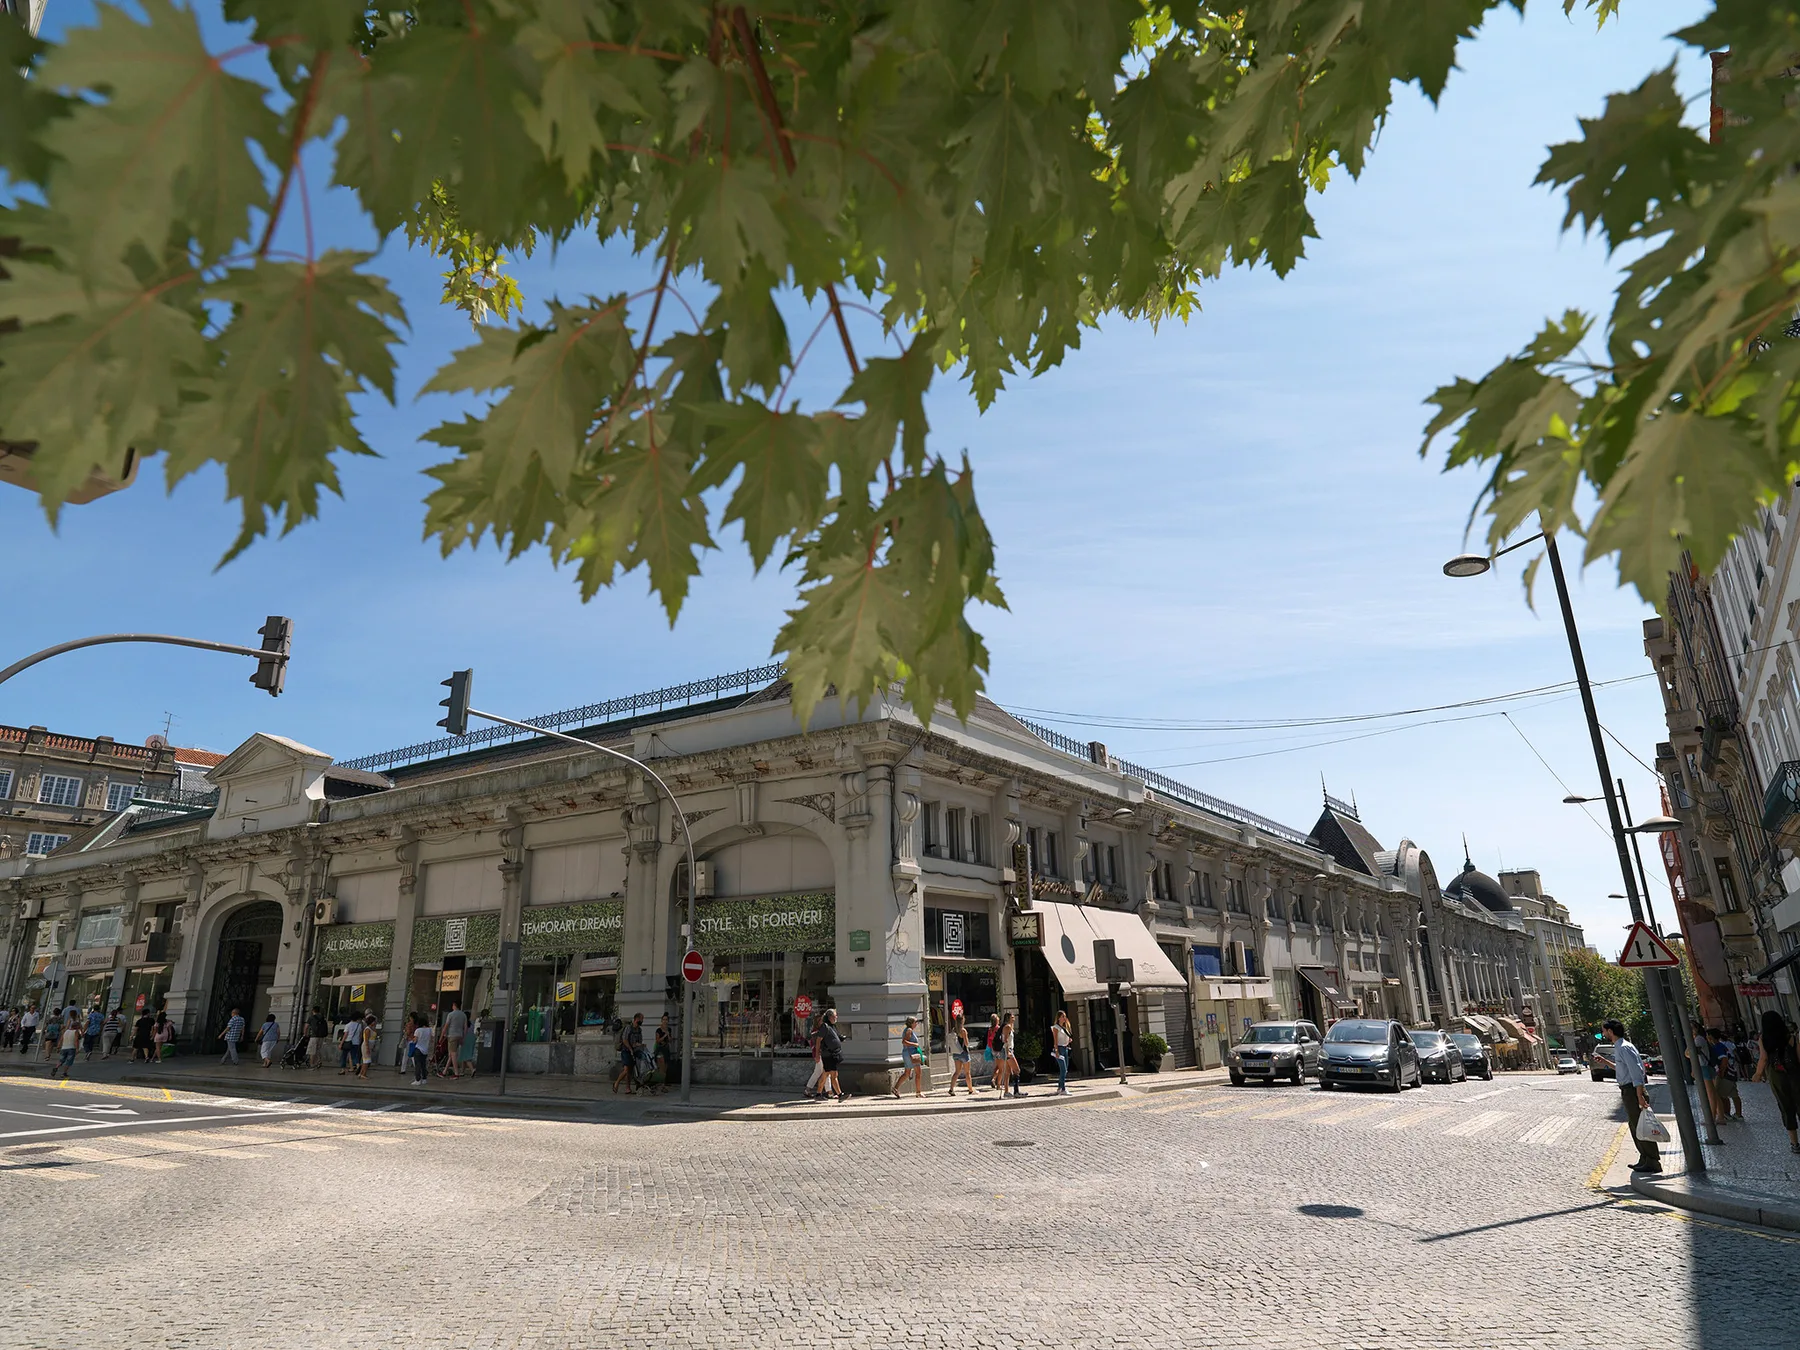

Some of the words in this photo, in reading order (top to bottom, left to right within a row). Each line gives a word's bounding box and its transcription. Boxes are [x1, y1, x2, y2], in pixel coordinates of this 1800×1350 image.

[748, 915, 759, 929] IS
[762, 909, 822, 928] FOREVER!
[522, 919, 577, 935] TEMPORARY
[325, 940, 337, 952] ALL
[339, 937, 368, 950] DREAMS
[794, 1002, 812, 1012] -50%
